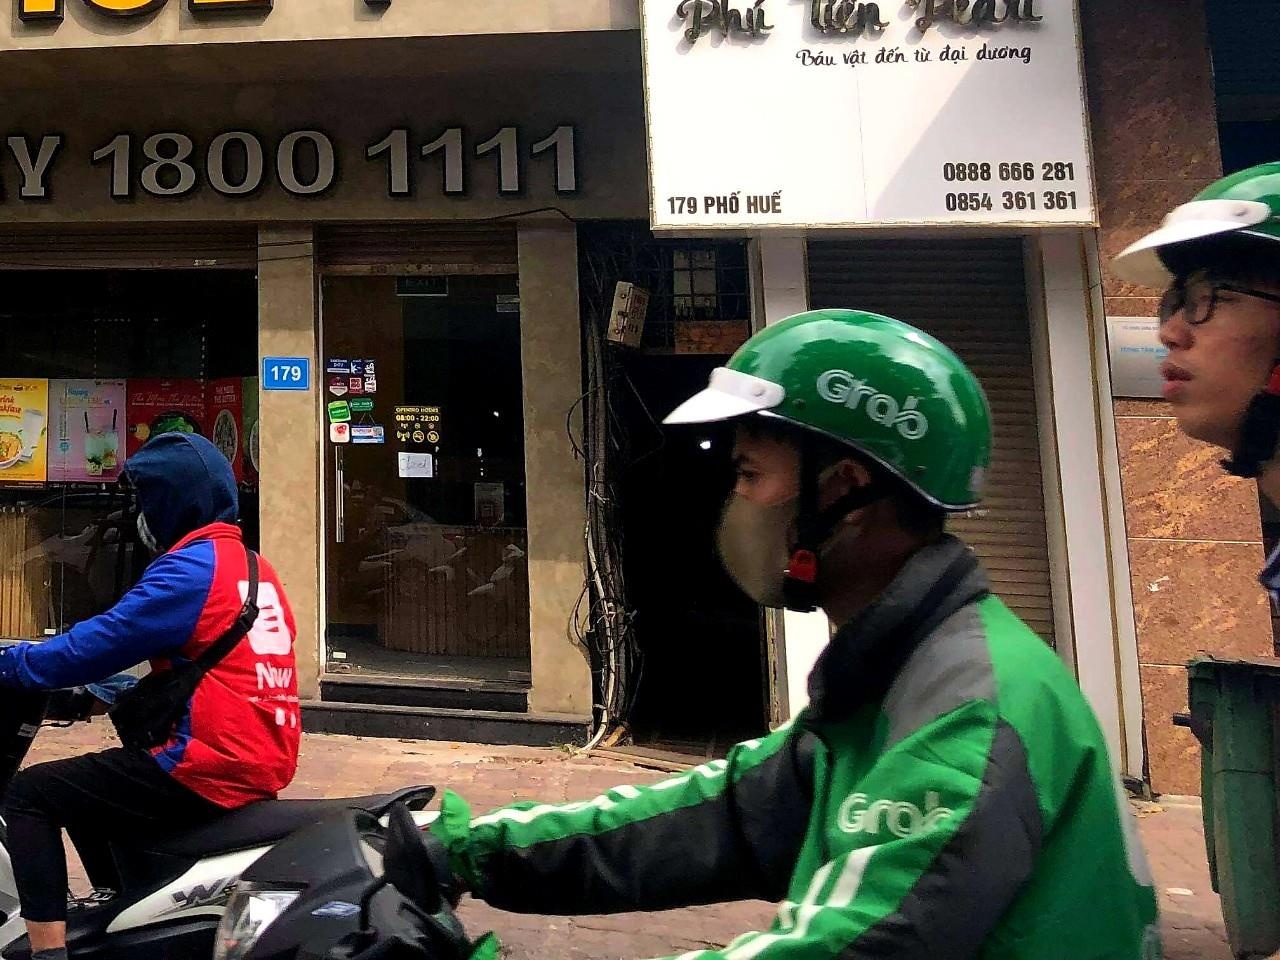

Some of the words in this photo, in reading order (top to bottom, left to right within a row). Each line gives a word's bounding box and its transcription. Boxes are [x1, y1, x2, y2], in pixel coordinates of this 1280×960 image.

[796, 48, 836, 66] Báu
[843, 49, 868, 68] vật
[874, 44, 908, 64] đến
[913, 46, 931, 63] từ
[939, 44, 968, 64] đại
[976, 44, 1032, 64] dương
[92, 129, 336, 197] 1800
[365, 124, 579, 195] 1111
[943, 163, 991, 182] 0888
[999, 162, 1034, 181] 666
[1041, 162, 1074, 181] 281
[667, 196, 698, 215] 179
[703, 191, 740, 215] PHỐ
[746, 190, 782, 214] HUẾ
[945, 192, 993, 211] 0854
[1002, 192, 1036, 210] 361
[1043, 191, 1077, 210] 361
[270, 365, 302, 382] 179
[816, 368, 929, 441] Grab
[838, 791, 953, 838] Grab
